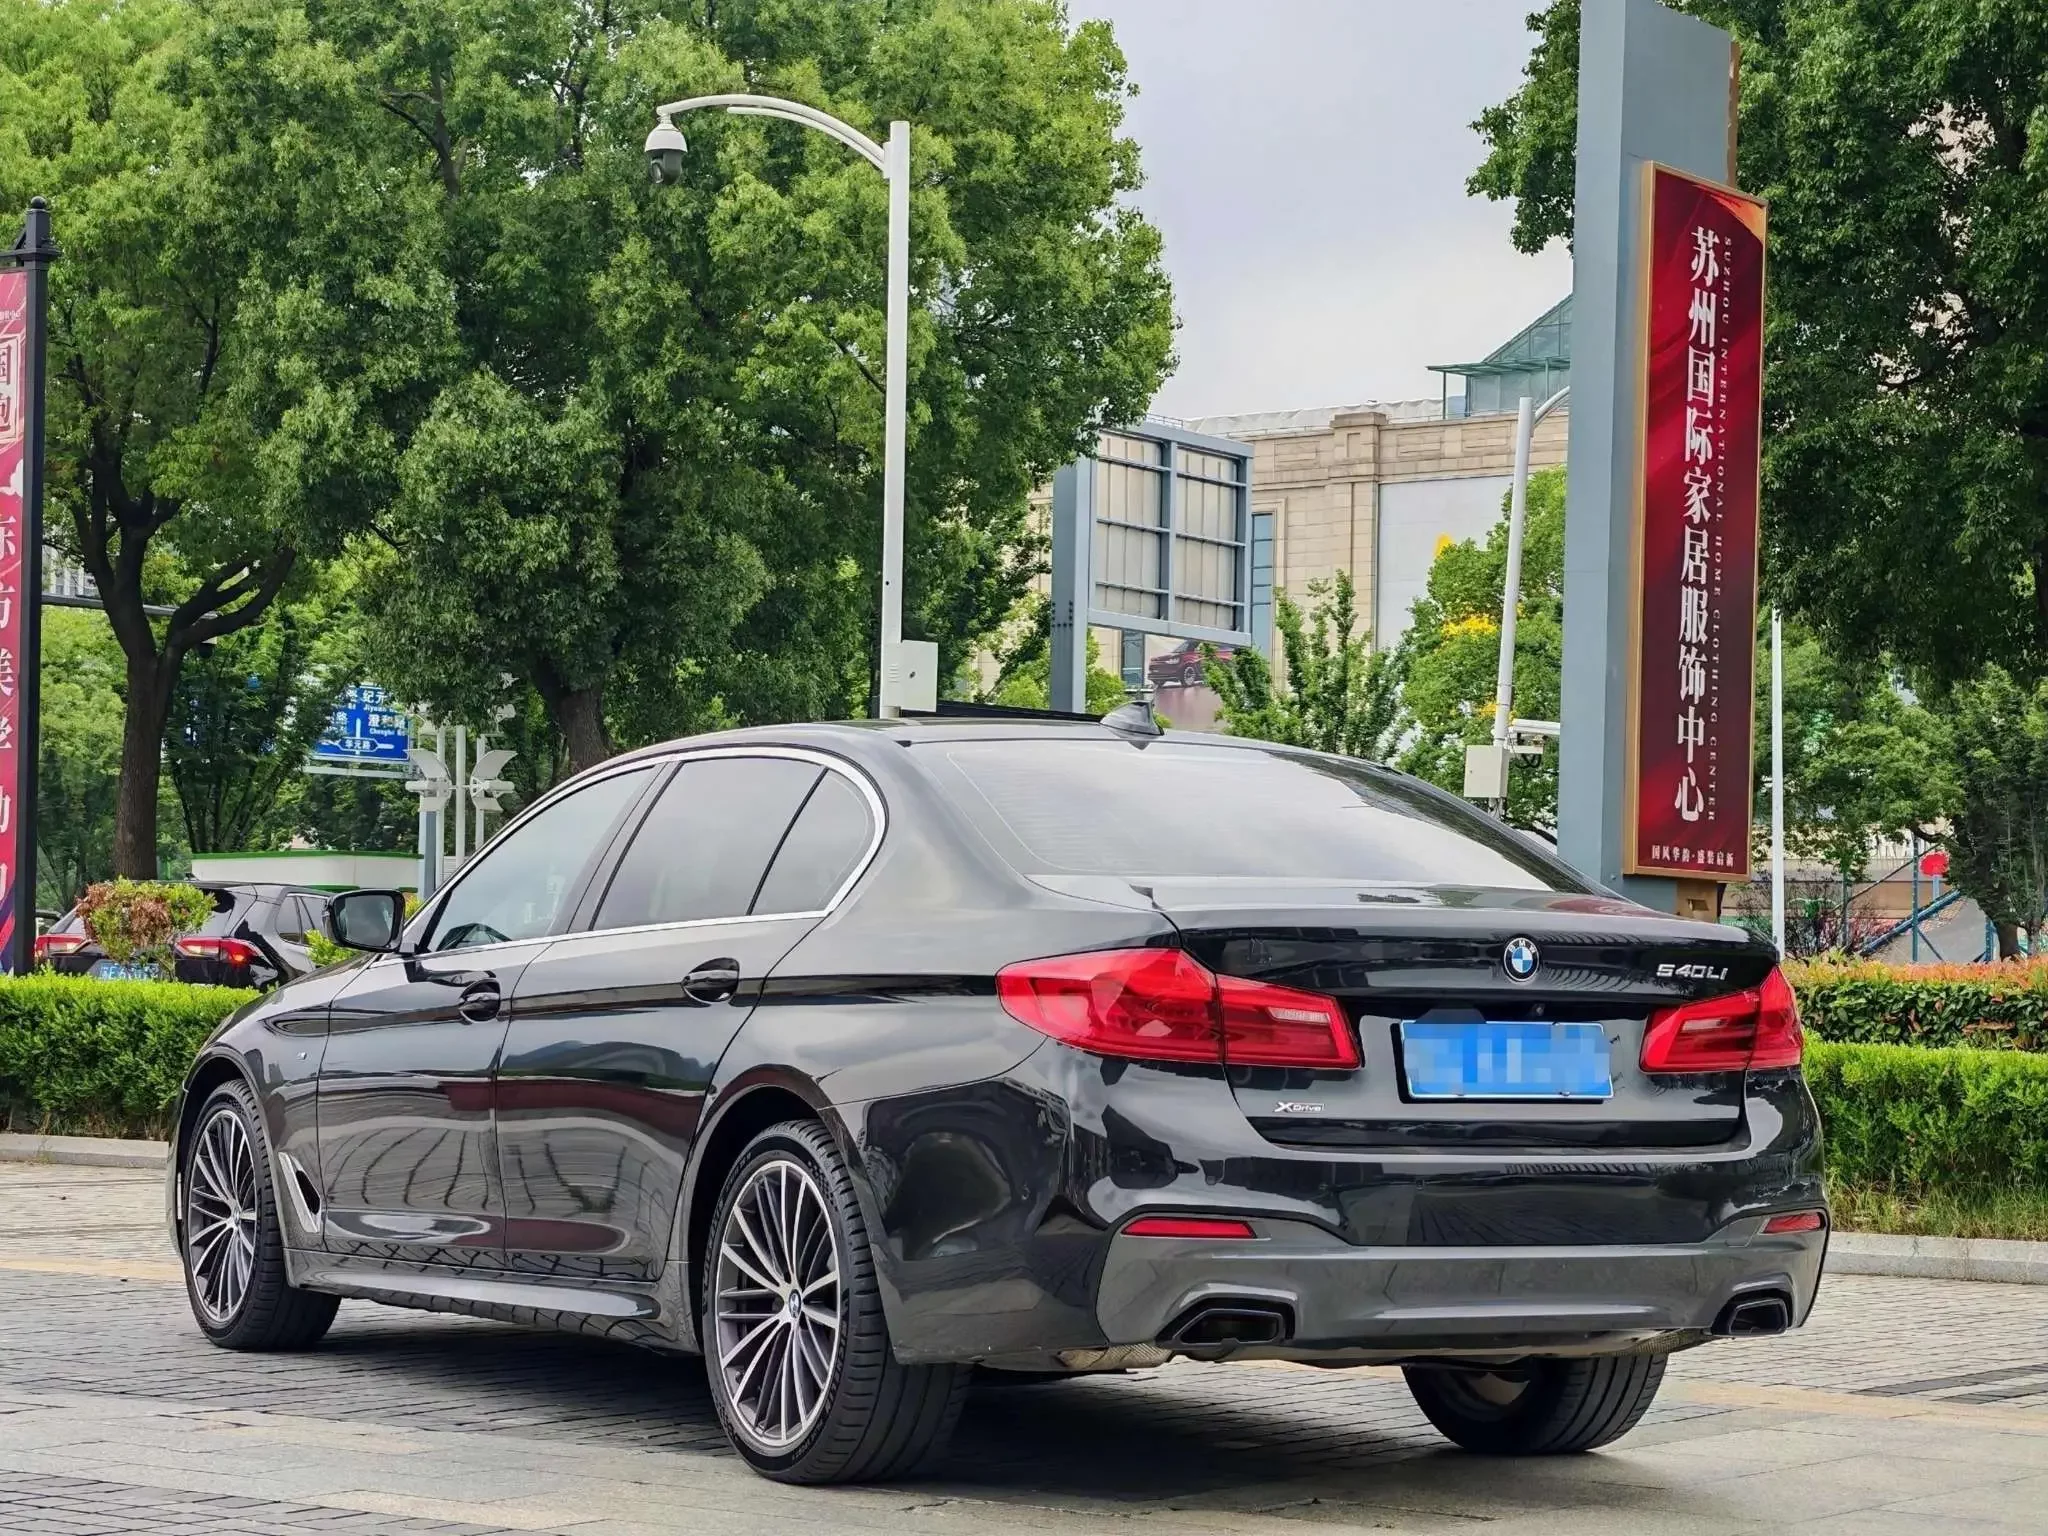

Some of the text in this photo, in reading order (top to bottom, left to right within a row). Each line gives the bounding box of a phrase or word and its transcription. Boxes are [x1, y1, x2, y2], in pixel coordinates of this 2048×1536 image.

[1674, 225, 1720, 821] 苏州国际家居服饰中心
[1708, 235, 1732, 820] SUZHOU INTERNATIONAL HOME CLOTHING CENTER
